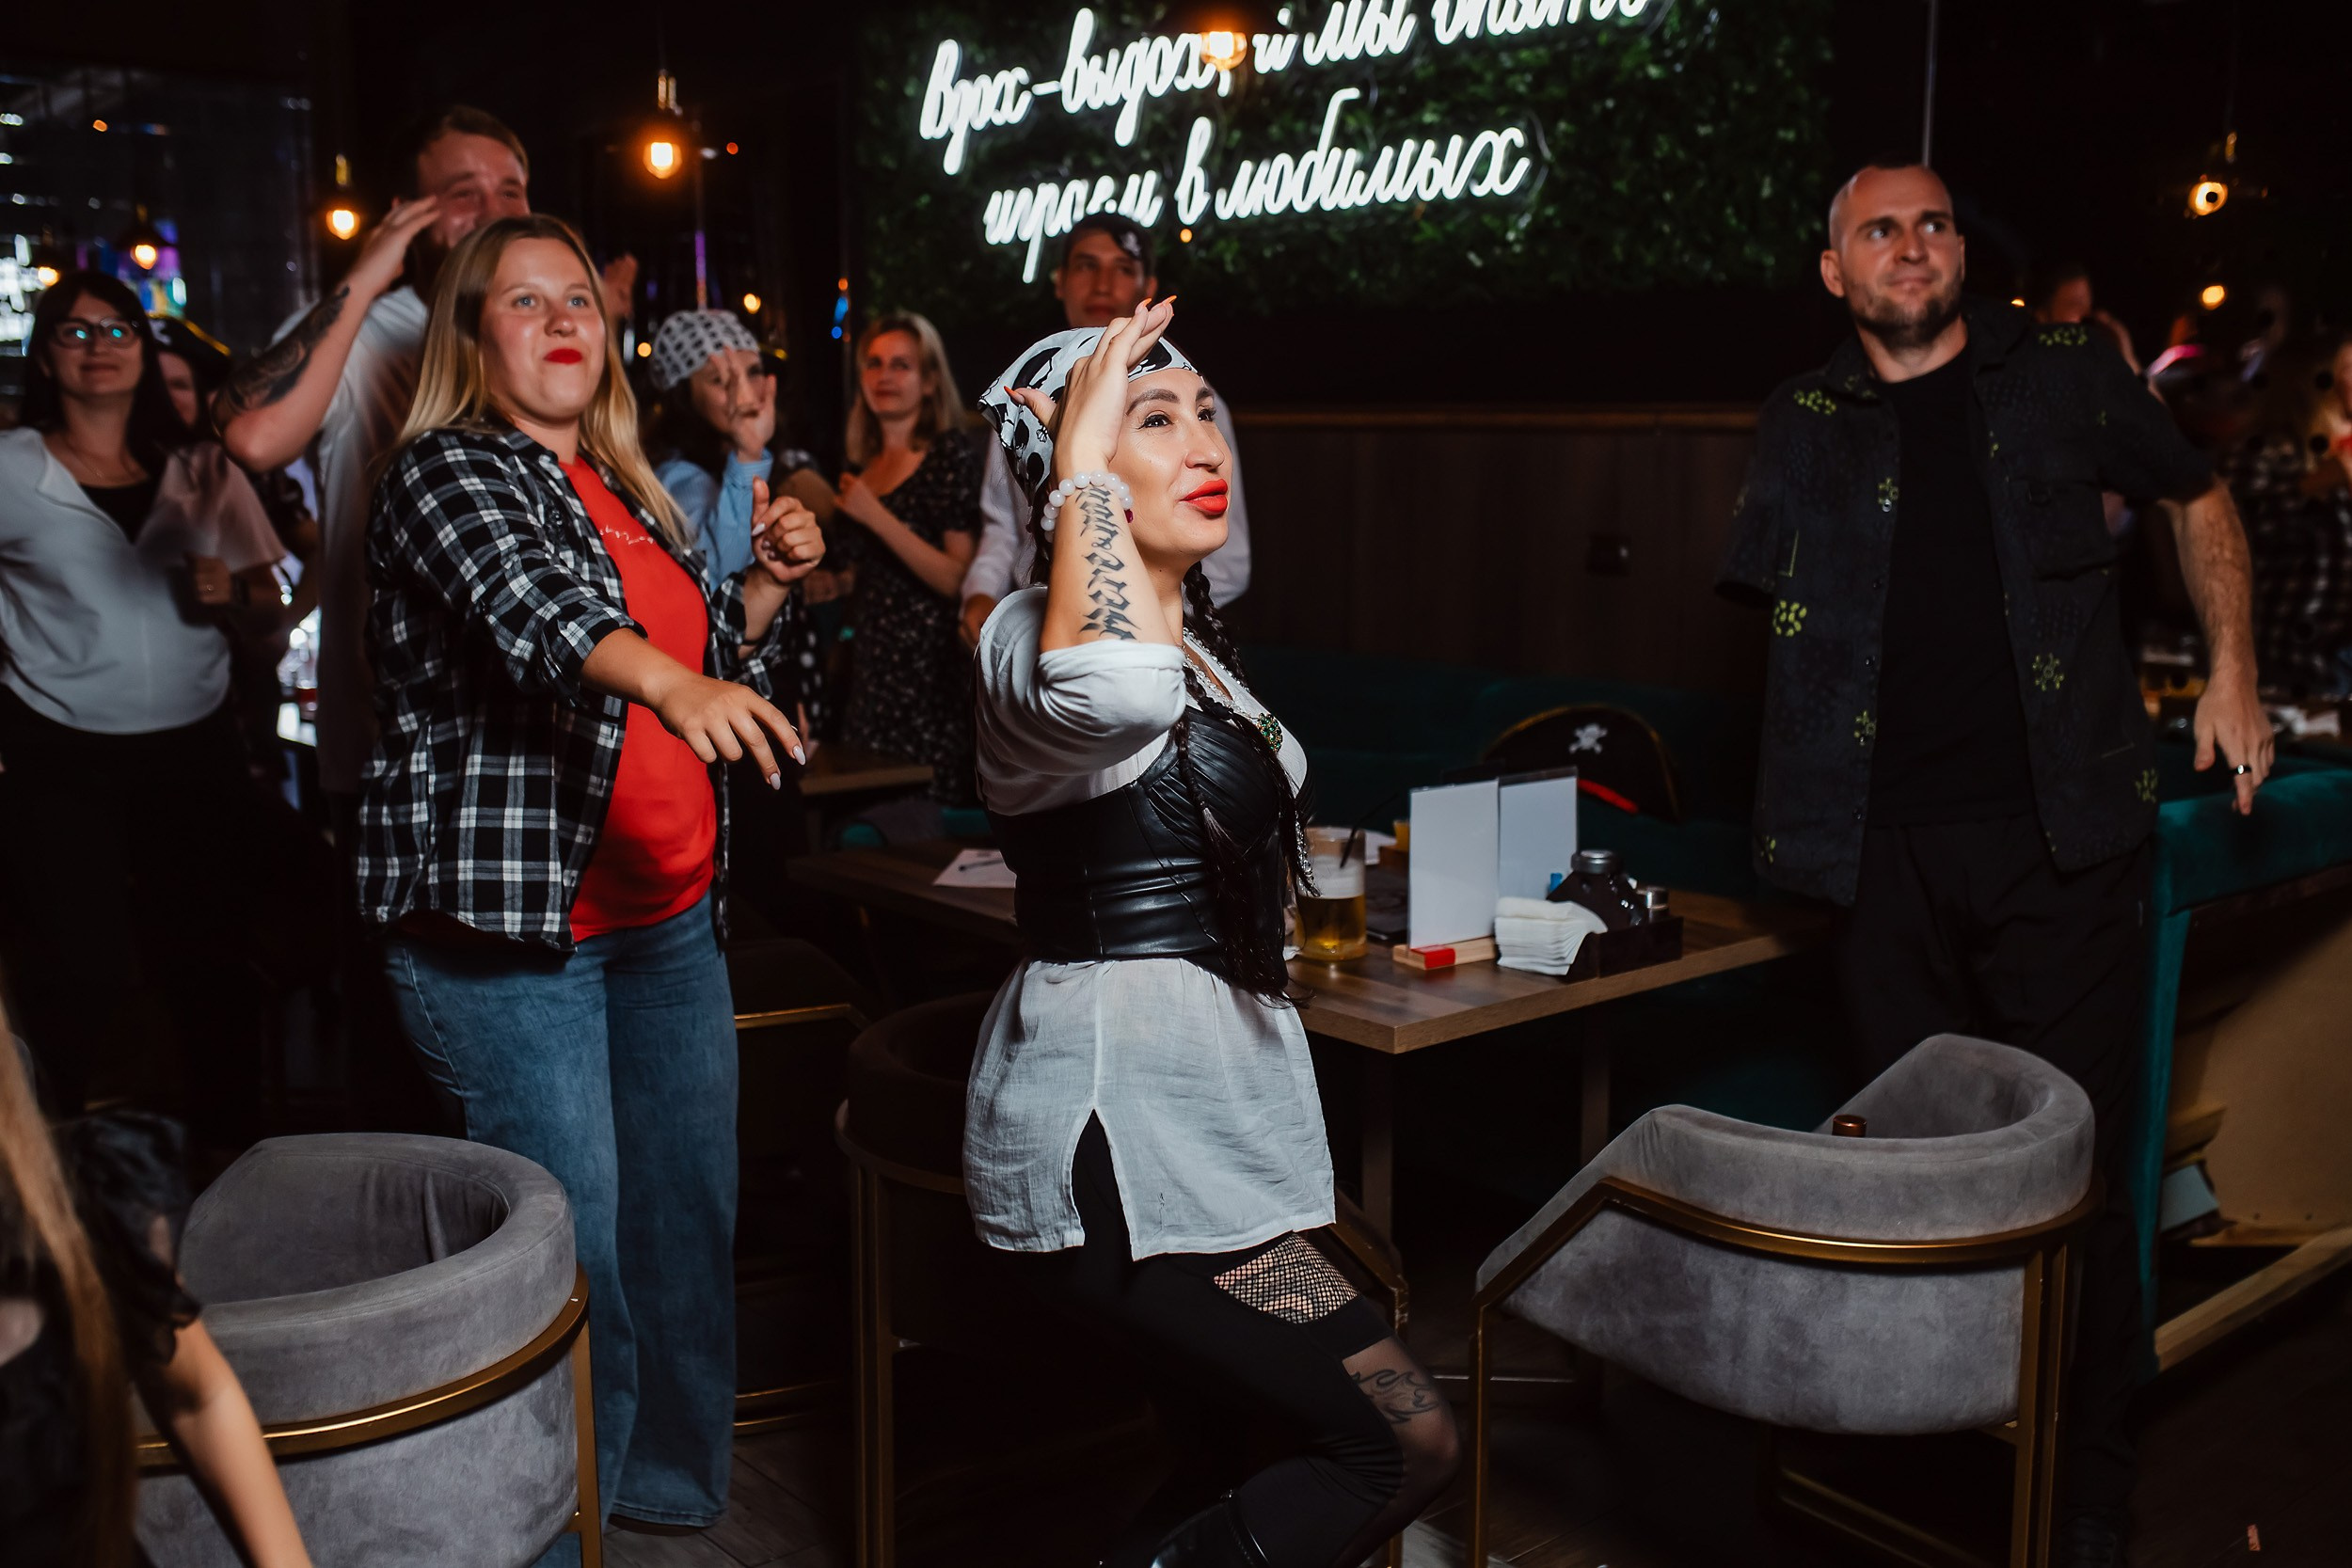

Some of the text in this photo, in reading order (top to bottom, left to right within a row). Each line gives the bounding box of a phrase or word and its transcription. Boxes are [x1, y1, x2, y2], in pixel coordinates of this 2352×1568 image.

[1302, 0, 1417, 66] мы
[1174, 116, 1212, 225] в
[1215, 87, 1531, 220] любимых
